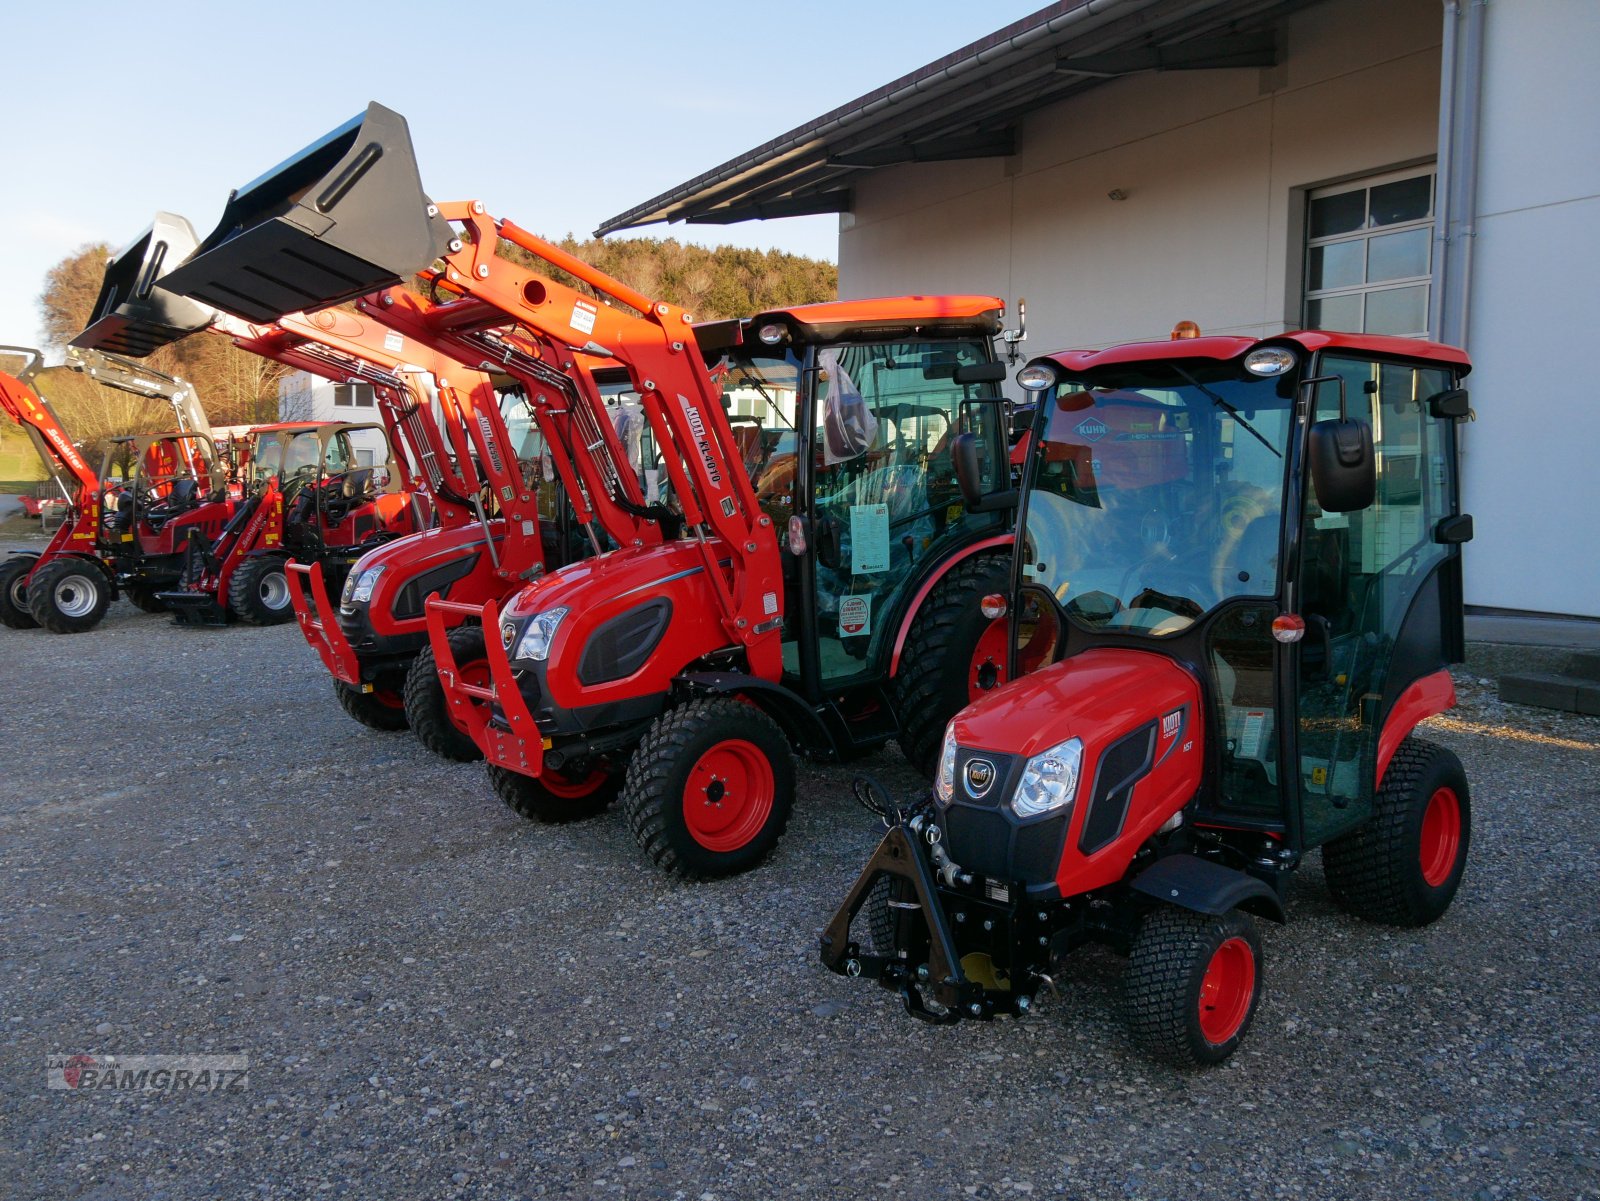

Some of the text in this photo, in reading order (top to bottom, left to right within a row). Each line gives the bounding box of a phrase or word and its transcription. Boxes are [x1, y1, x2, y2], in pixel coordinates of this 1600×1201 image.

[479, 416, 494, 438] KIOTI
[685, 406, 706, 437] KIOTI
[1079, 425, 1106, 434] KUHN
[1163, 710, 1180, 734] KIOTI
